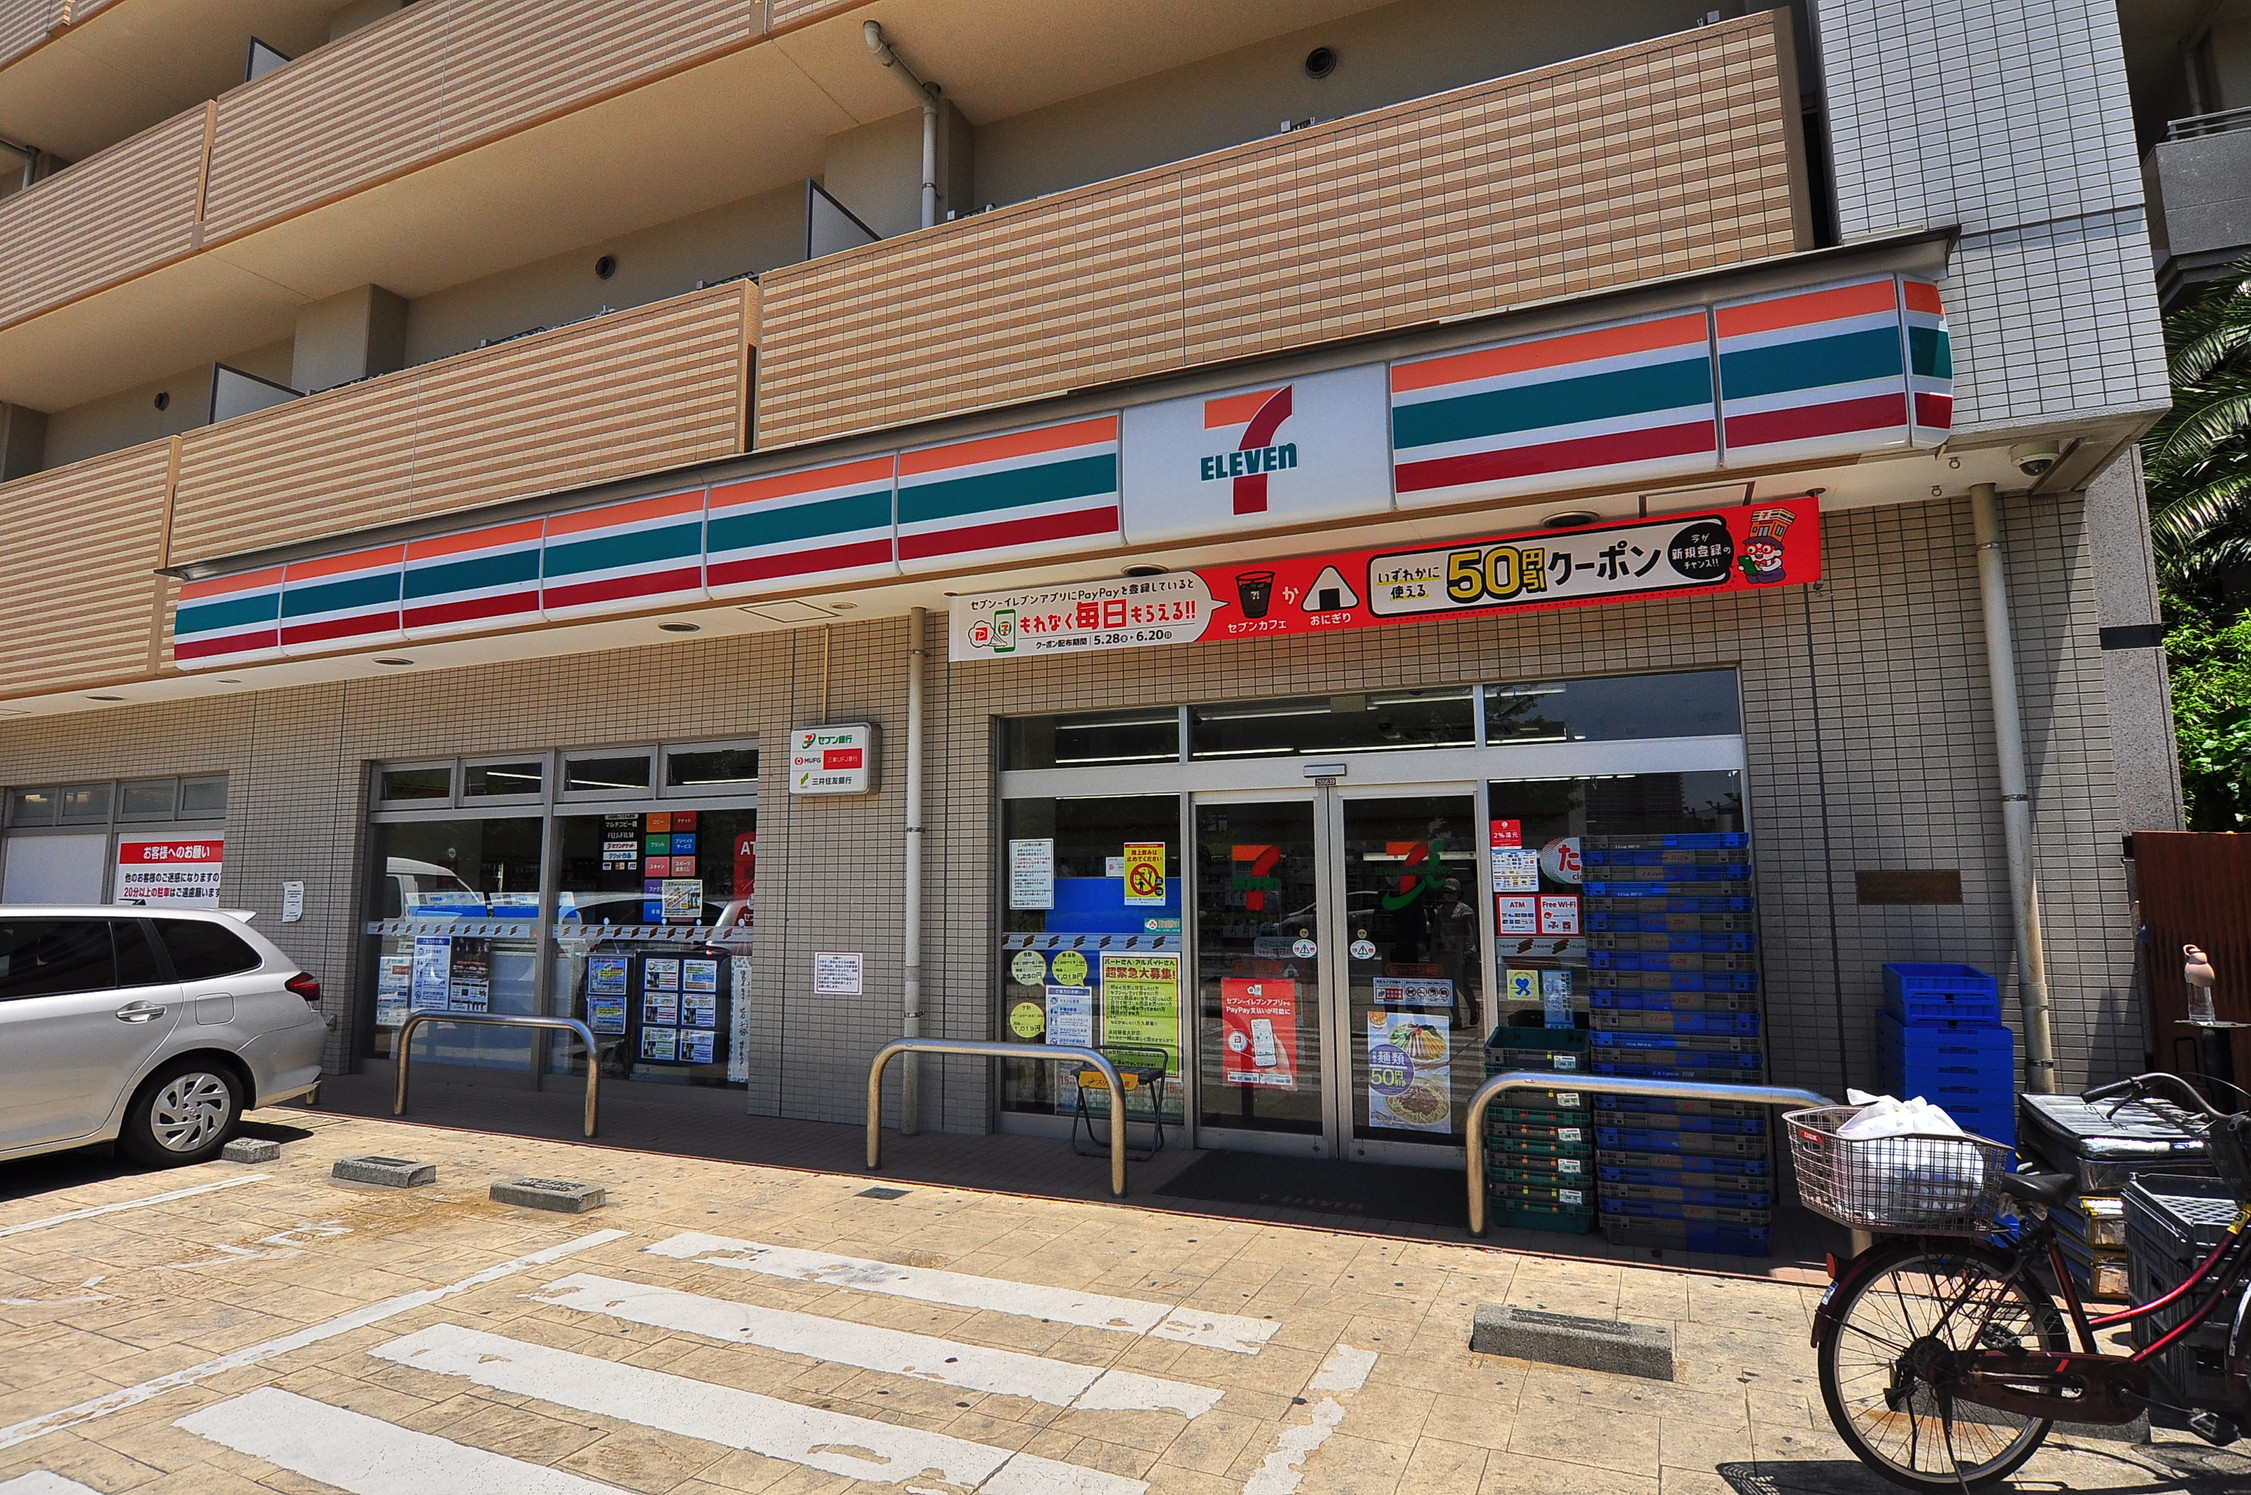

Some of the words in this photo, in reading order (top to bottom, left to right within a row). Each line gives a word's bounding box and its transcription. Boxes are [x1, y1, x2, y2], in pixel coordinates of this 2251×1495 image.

[1691, 533, 1710, 543] 今が
[1671, 545, 1731, 560] 新規登録の
[1377, 566, 1441, 584] いずれかに
[1282, 586, 1299, 605] か
[1390, 584, 1427, 599] 使える
[1227, 619, 1287, 633] セブンカフェ
[1310, 613, 1352, 627] おにぎり
[1036, 637, 1087, 649] クーポン配布期間
[818, 734, 852, 745] セブン銀行
[812, 776, 852, 786] 三井住友銀行
[143, 845, 211, 860] お客様へのお願い
[125, 872, 221, 883] 他のお客様のご迷惑になりますの
[1105, 967, 1176, 980] 超緊急大募集!
[1226, 1006, 1291, 1015] PayPay支払いが可能に
[1377, 1050, 1405, 1065] 麺類
